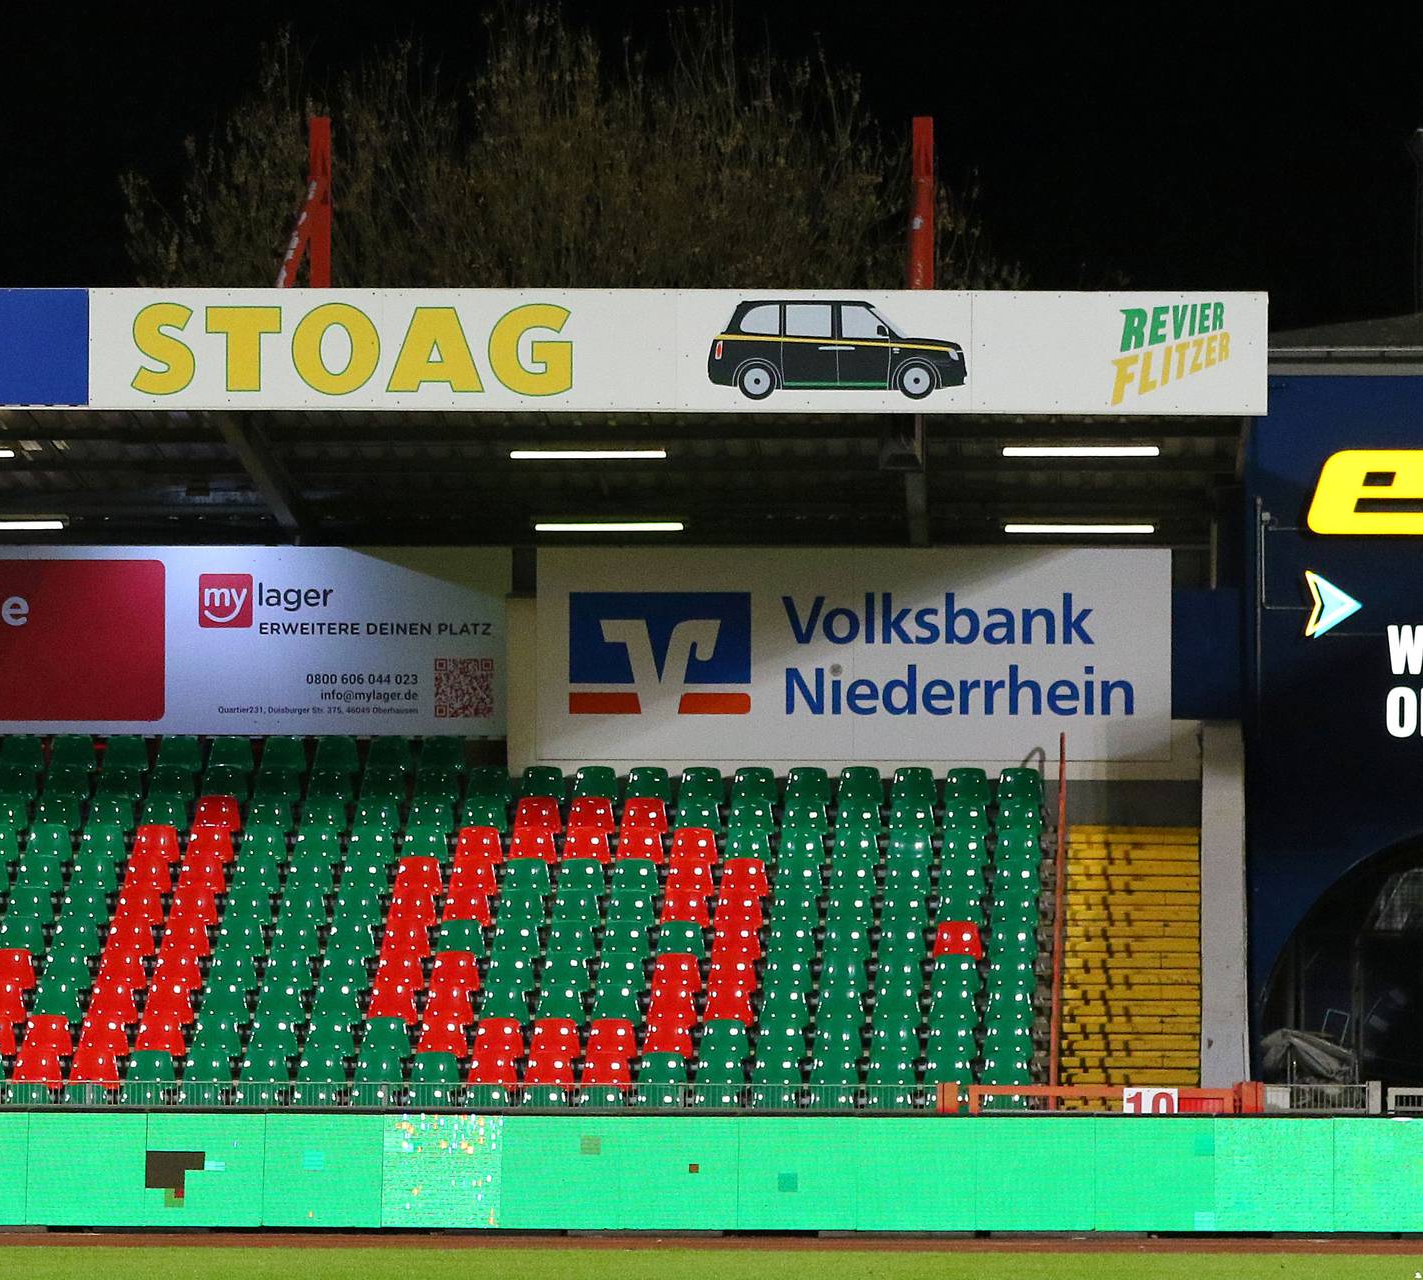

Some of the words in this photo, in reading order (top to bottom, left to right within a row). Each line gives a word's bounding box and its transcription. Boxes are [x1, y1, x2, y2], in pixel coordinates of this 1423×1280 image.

[130, 302, 574, 397] STOAG
[1119, 301, 1225, 353] REVIER
[1110, 331, 1232, 406] FLITZER
[203, 586, 248, 623] my
[258, 582, 334, 612] lager
[782, 592, 1095, 645] Volksbank
[259, 622, 361, 636] ERWEITERE
[366, 622, 432, 636] DEINEN
[438, 622, 493, 636] PLATZ
[306, 673, 338, 686] 0800
[341, 673, 365, 686] 606
[368, 673, 391, 686] 044
[395, 673, 419, 686] 023
[320, 689, 419, 703] info@mylager.de
[785, 664, 1135, 716] Niederrhein
